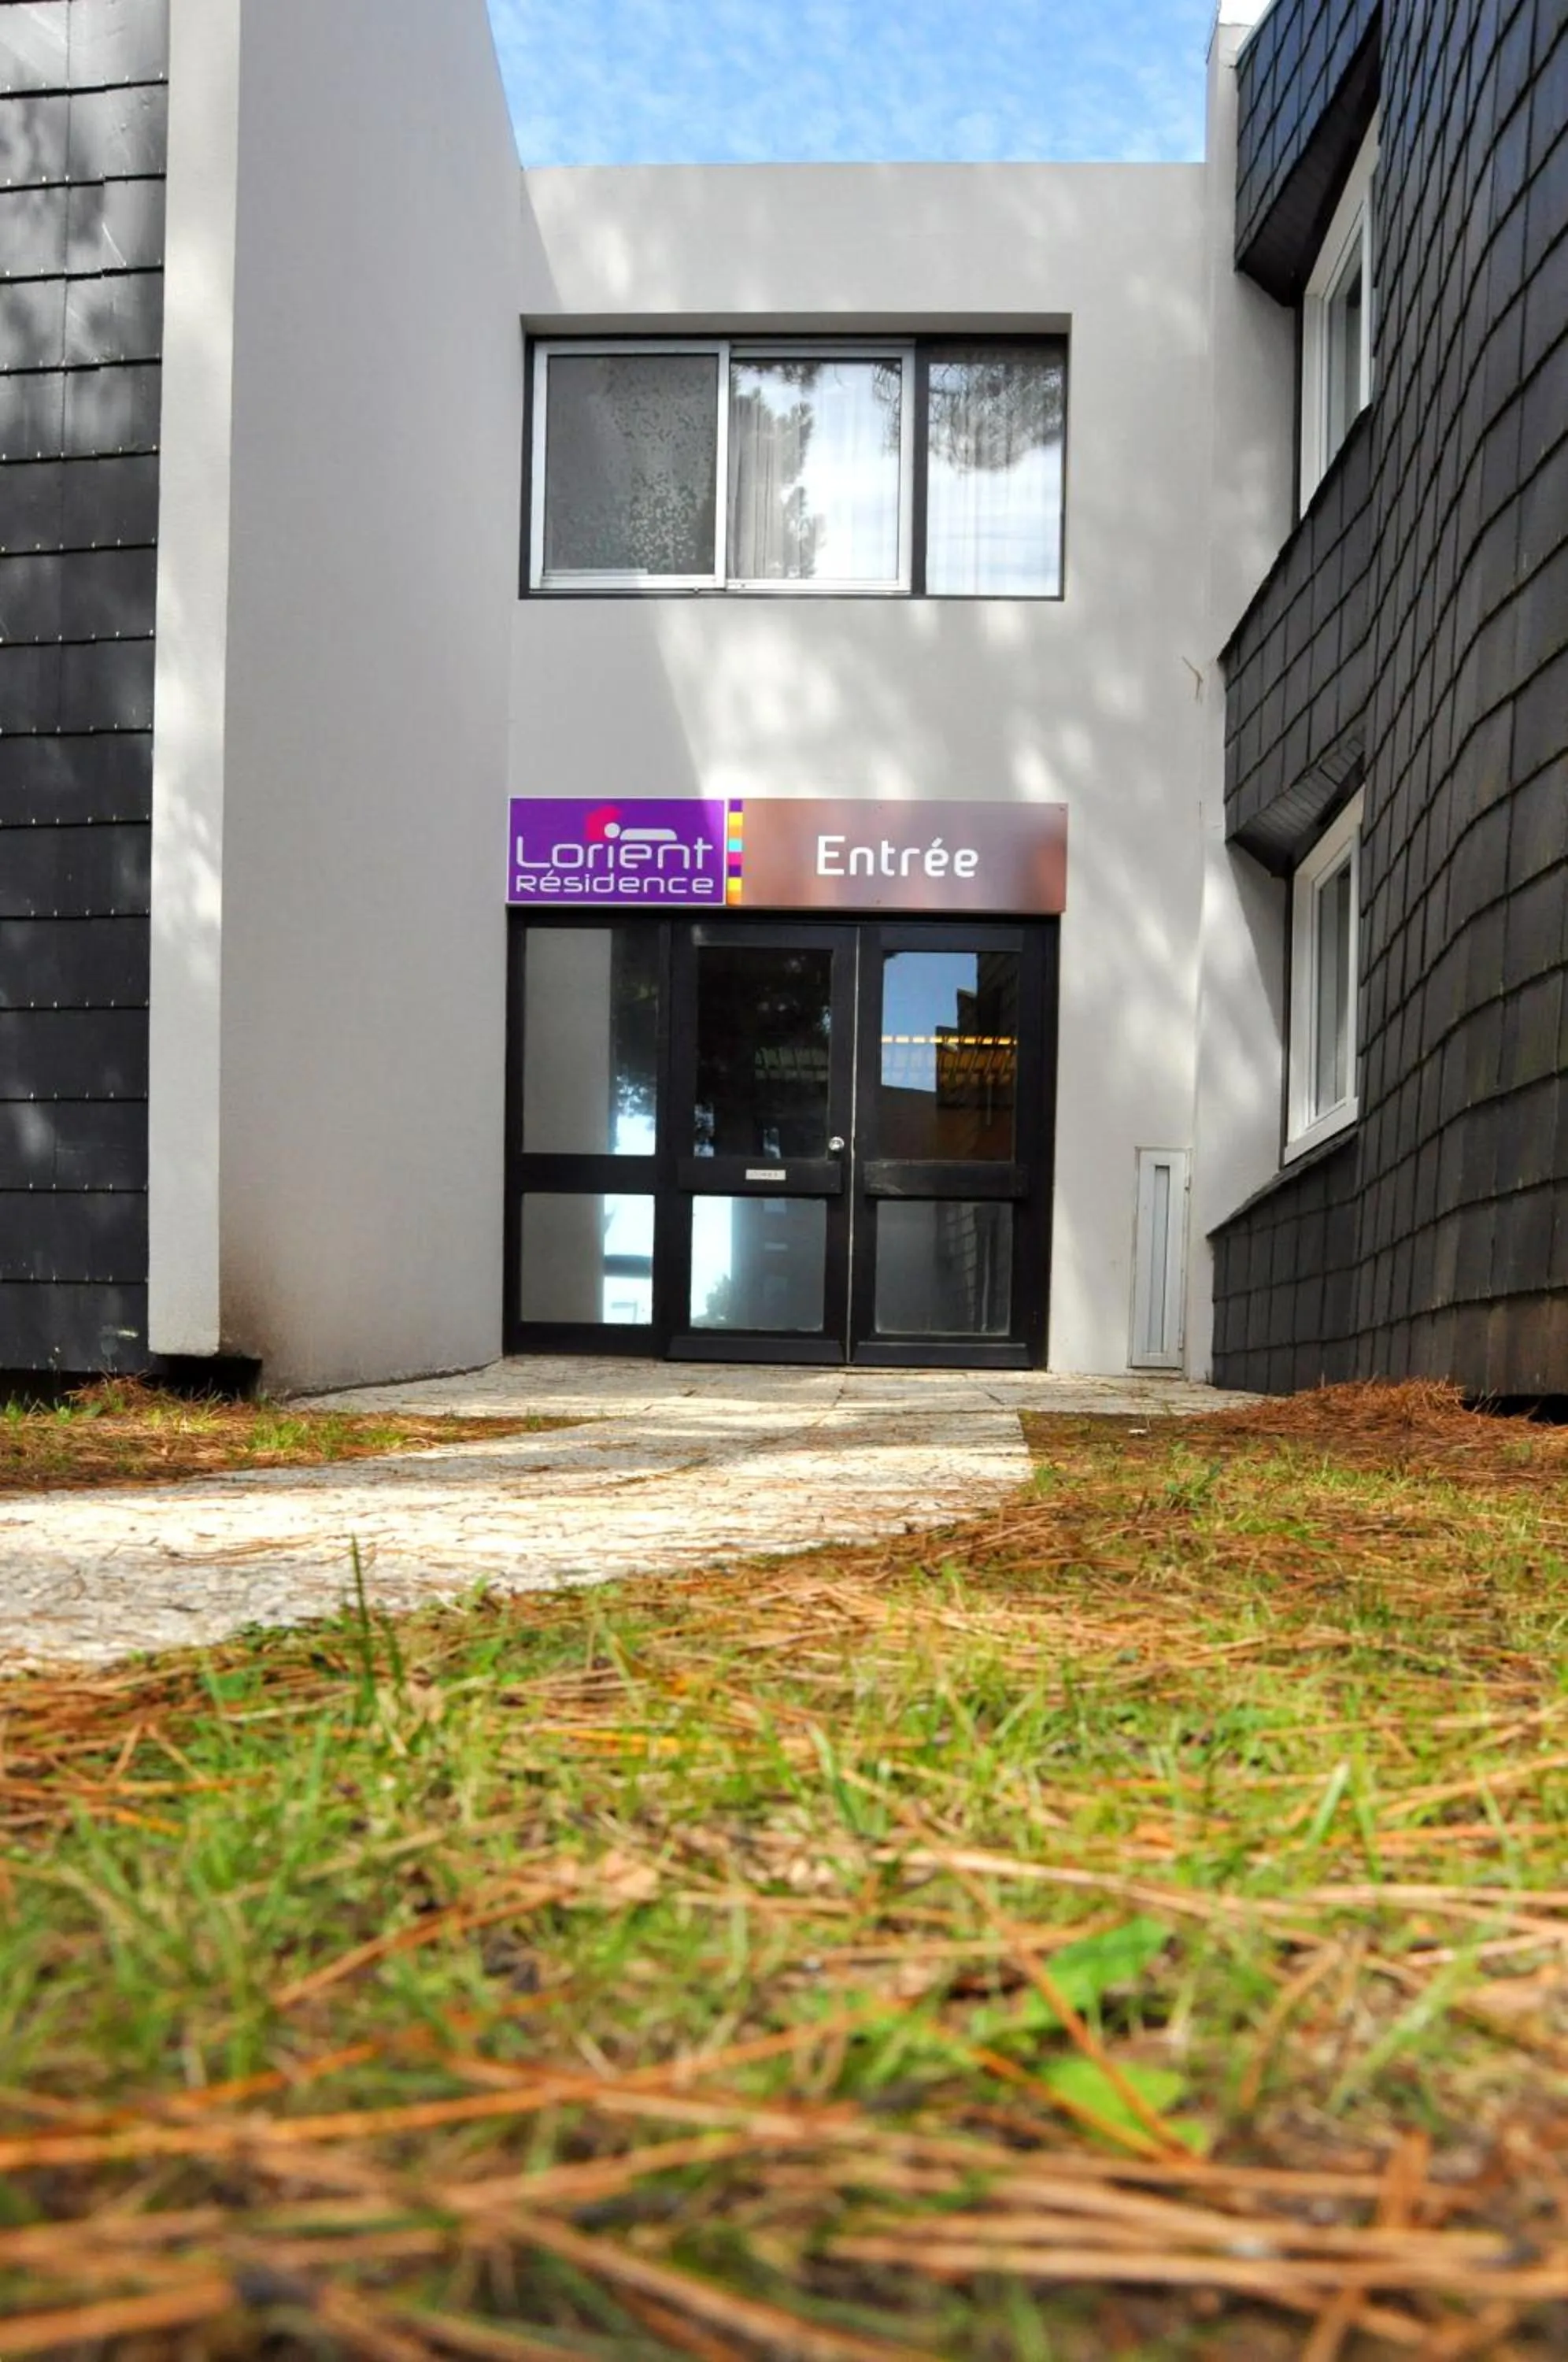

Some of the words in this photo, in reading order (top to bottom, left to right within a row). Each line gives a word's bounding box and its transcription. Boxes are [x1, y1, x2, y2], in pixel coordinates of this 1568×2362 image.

[516, 823, 713, 869] Lorient
[816, 835, 979, 878] Entrée
[516, 869, 714, 894] Résidence
